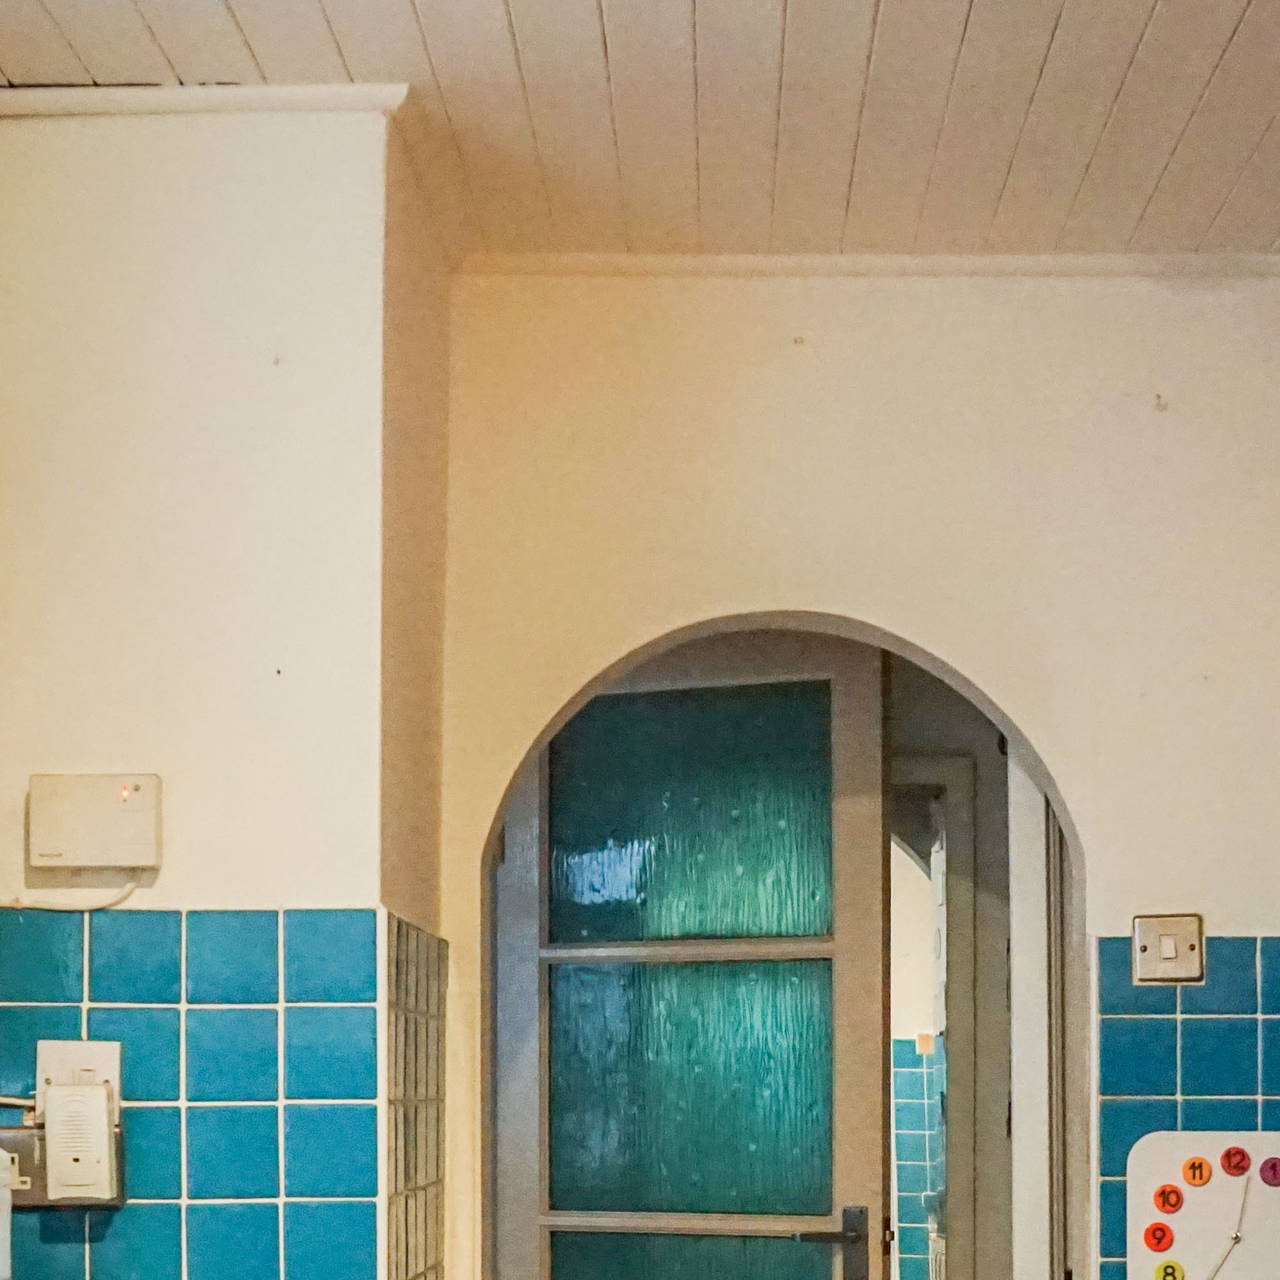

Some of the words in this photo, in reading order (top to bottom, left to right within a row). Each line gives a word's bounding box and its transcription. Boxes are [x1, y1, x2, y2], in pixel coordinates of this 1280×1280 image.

[1225, 1150, 1246, 1170] 12
[1189, 1161, 1203, 1181] 11
[1158, 1190, 1180, 1208] 10
[1152, 1227, 1166, 1245] 9
